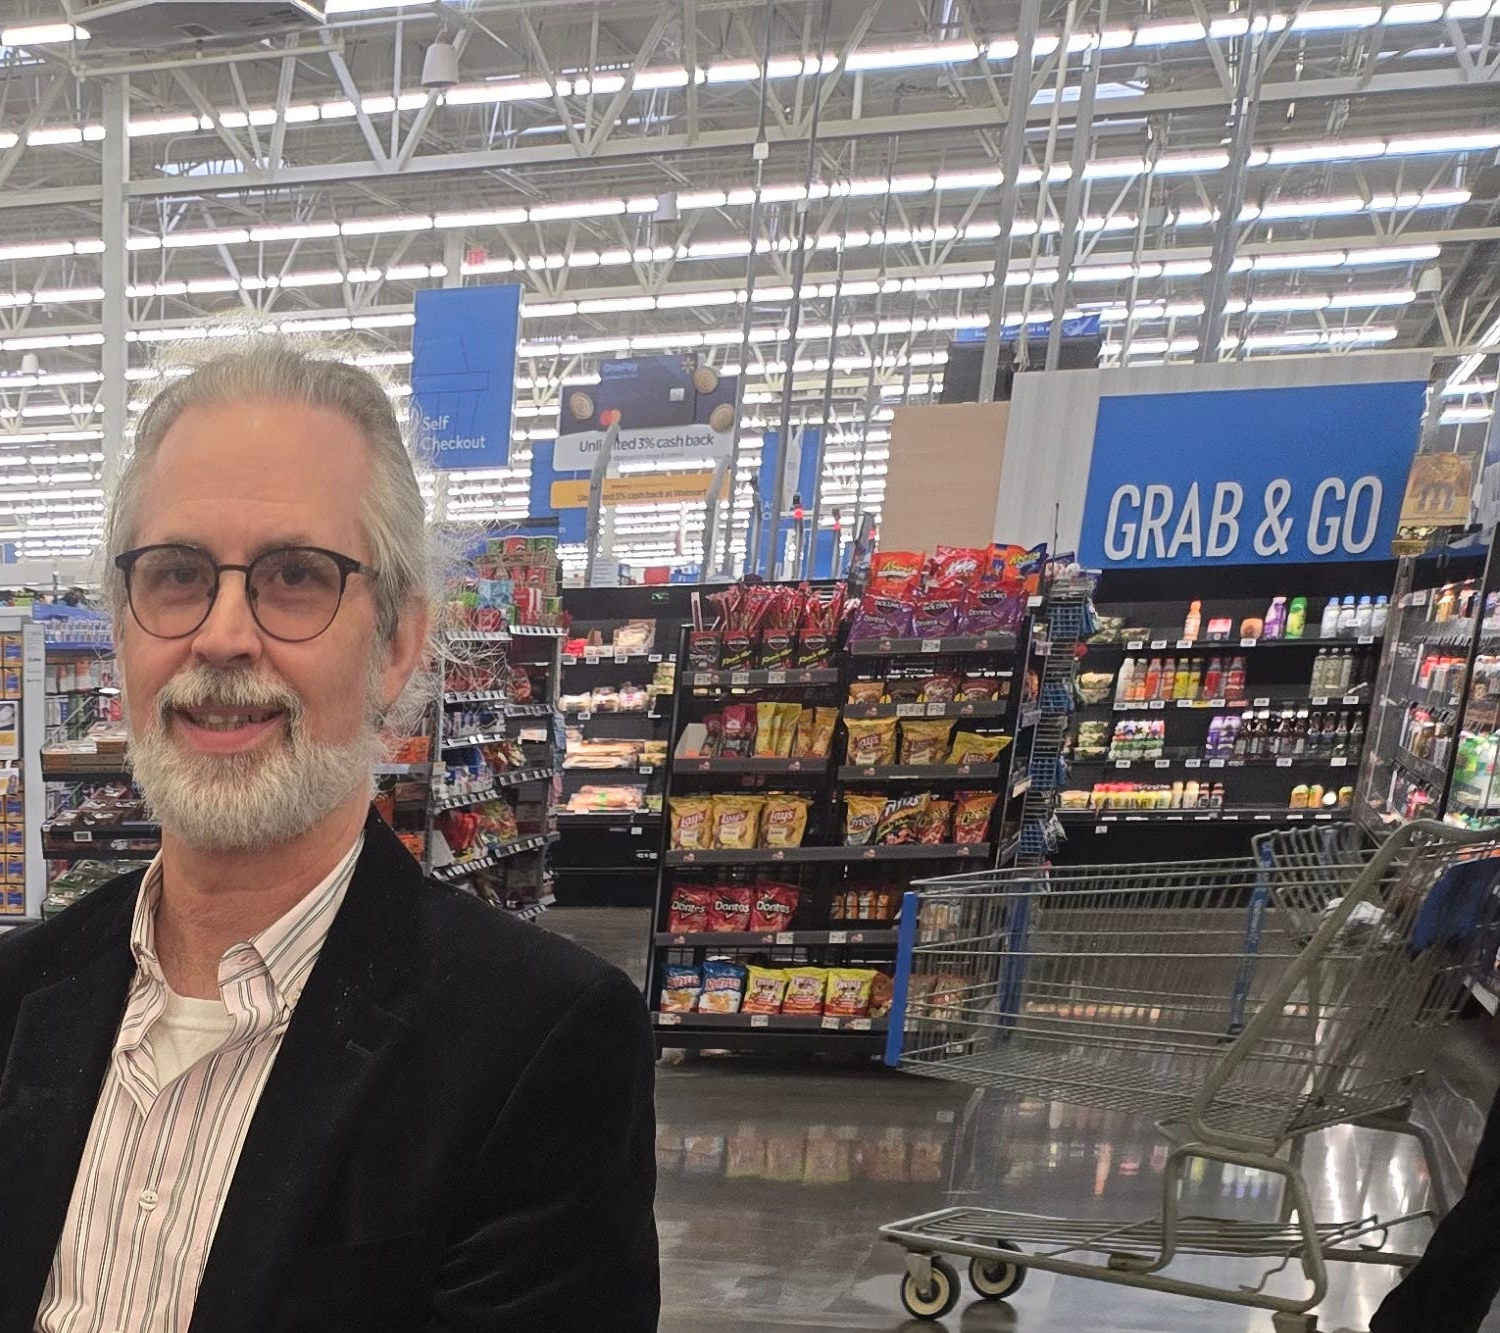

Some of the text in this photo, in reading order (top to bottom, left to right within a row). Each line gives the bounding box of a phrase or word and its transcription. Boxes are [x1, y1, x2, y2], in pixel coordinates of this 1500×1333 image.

[422, 416, 450, 431] Self
[421, 436, 487, 451] Checkout
[579, 433, 715, 453] Unliited 3% cash back
[1103, 475, 1384, 561] GRAB & GO
[671, 901, 705, 913] Doritos
[715, 901, 750, 913] Doritos
[756, 901, 790, 914] Doritos
